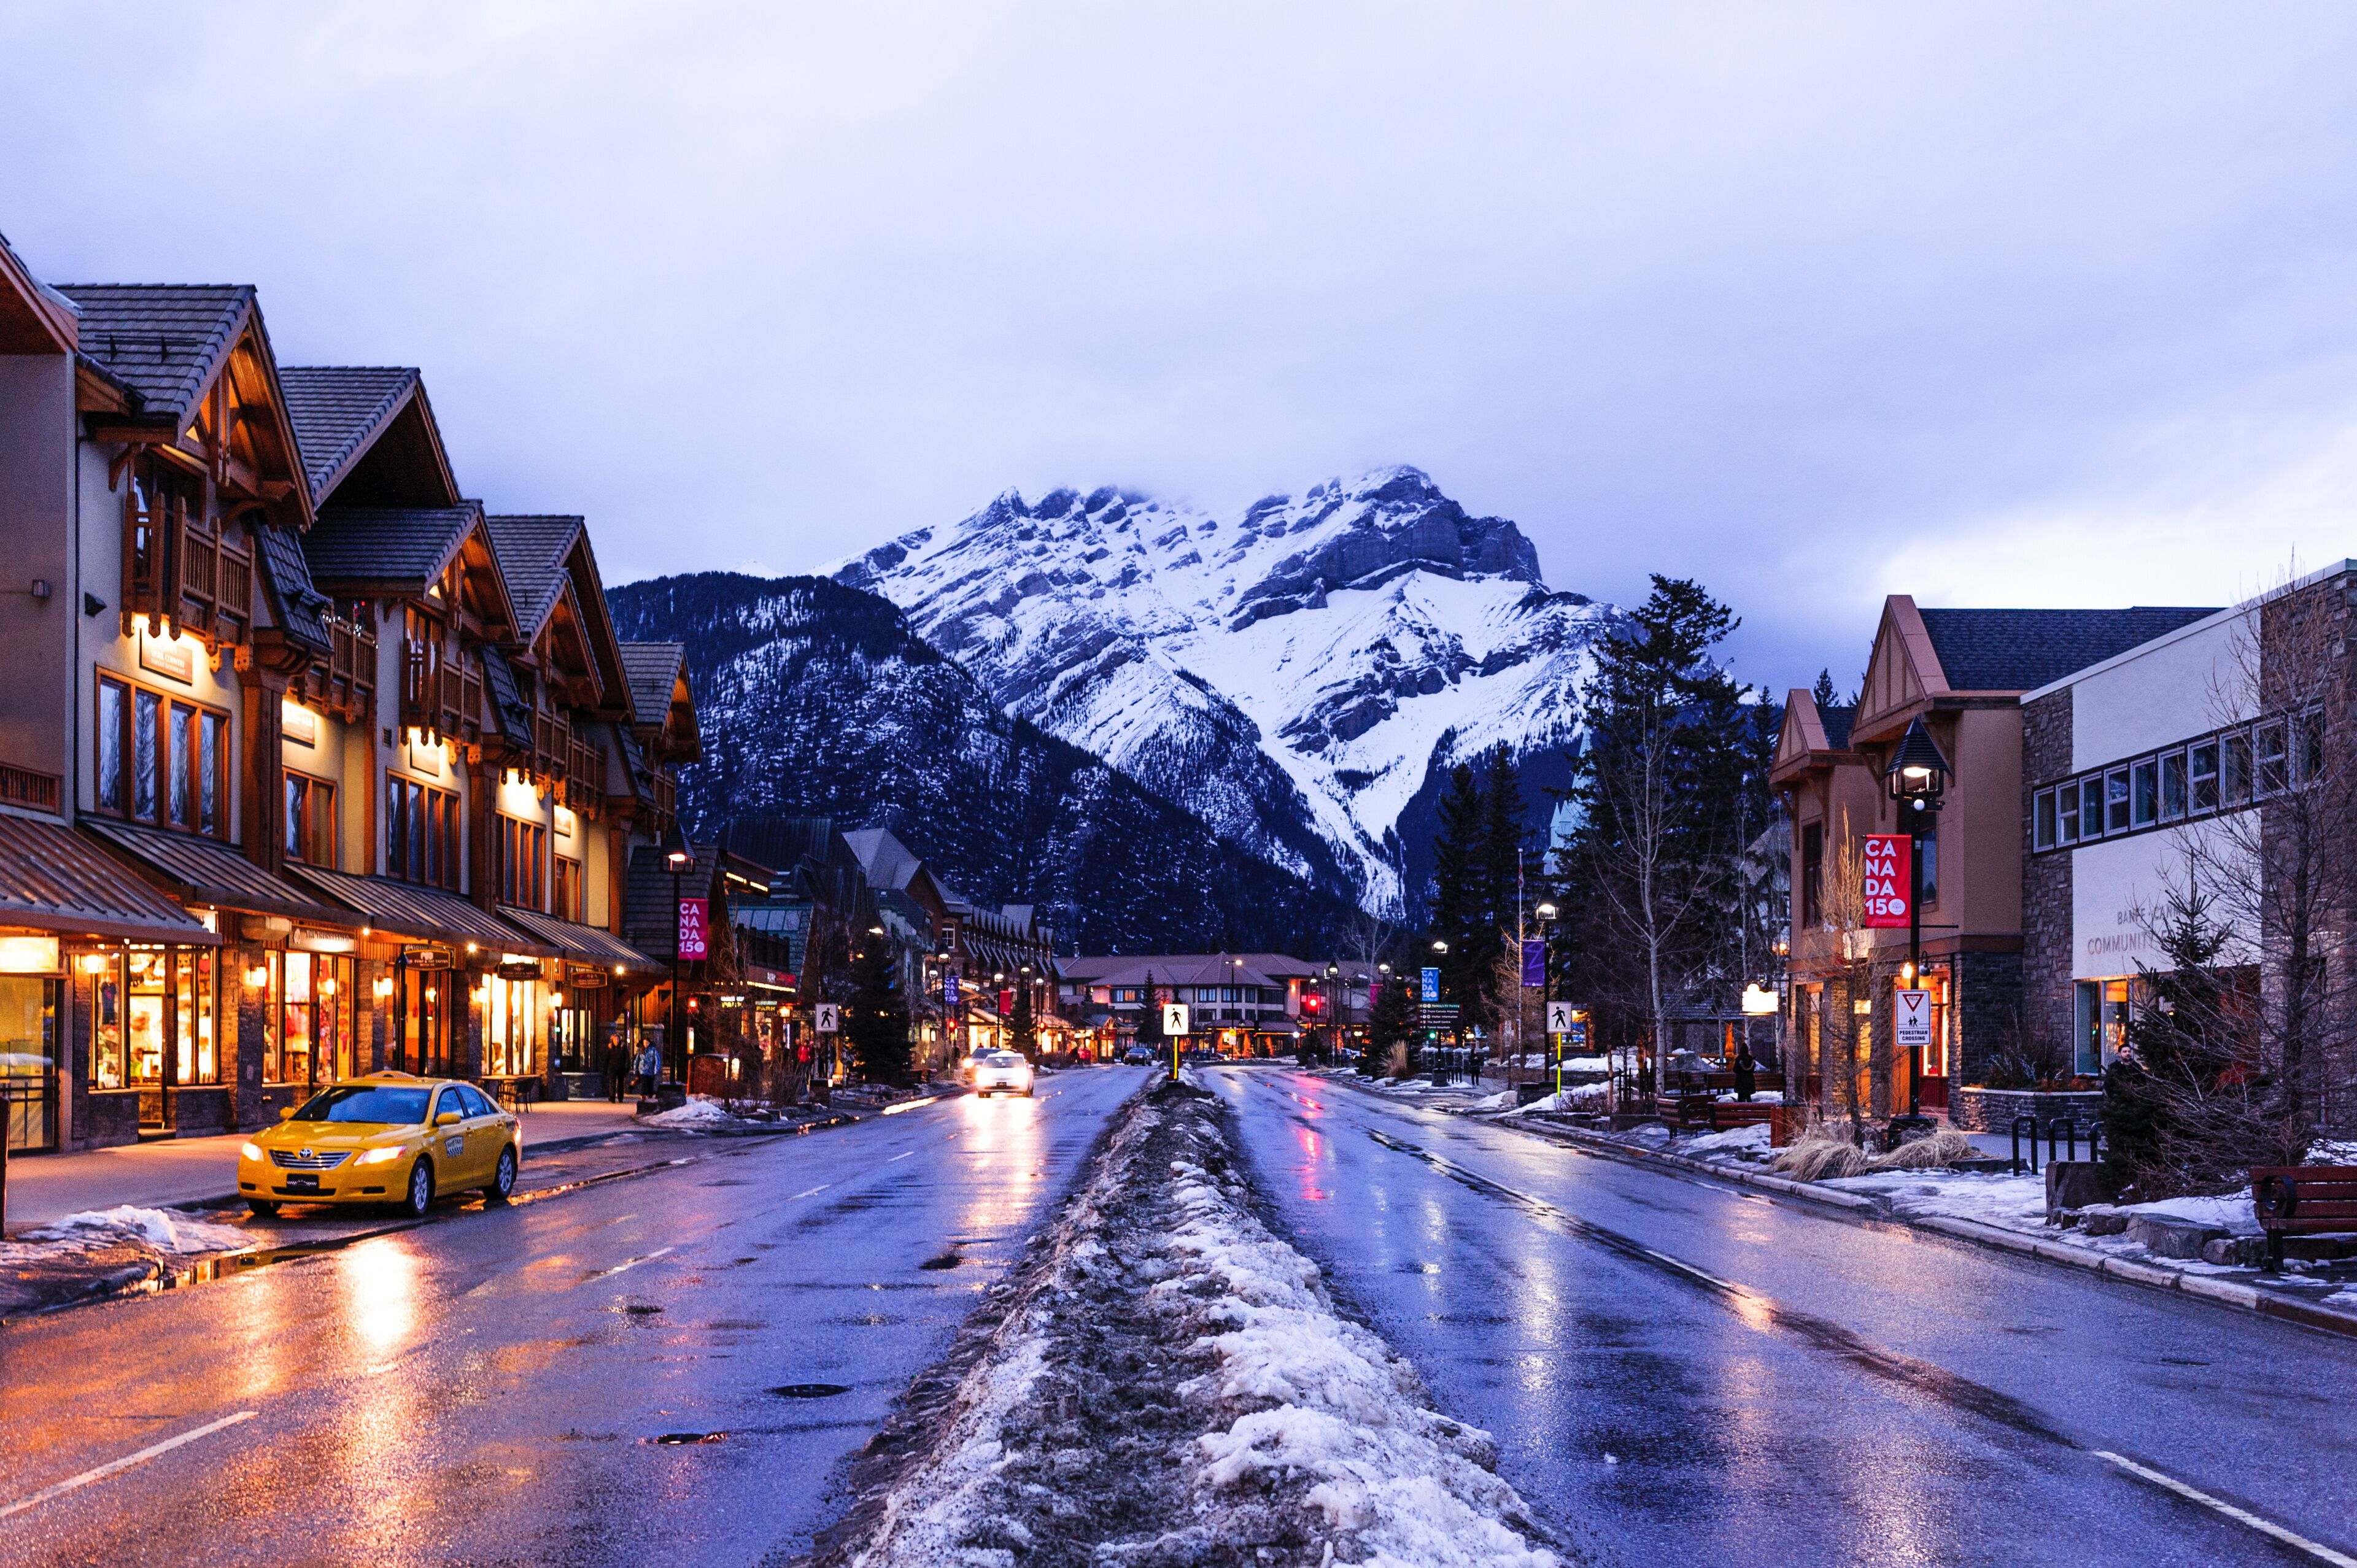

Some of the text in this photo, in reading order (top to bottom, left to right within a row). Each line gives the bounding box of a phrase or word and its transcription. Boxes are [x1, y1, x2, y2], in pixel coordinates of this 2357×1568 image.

[1865, 840, 1897, 857] CA
[1865, 859, 1896, 876] NA
[1865, 878, 1896, 896] DA
[679, 903, 700, 914] CA
[1865, 898, 1906, 916] 150
[679, 916, 700, 927] NA
[679, 928, 700, 940] DA
[679, 941, 705, 952] 150
[2087, 932, 2154, 955] COMMUNITY
